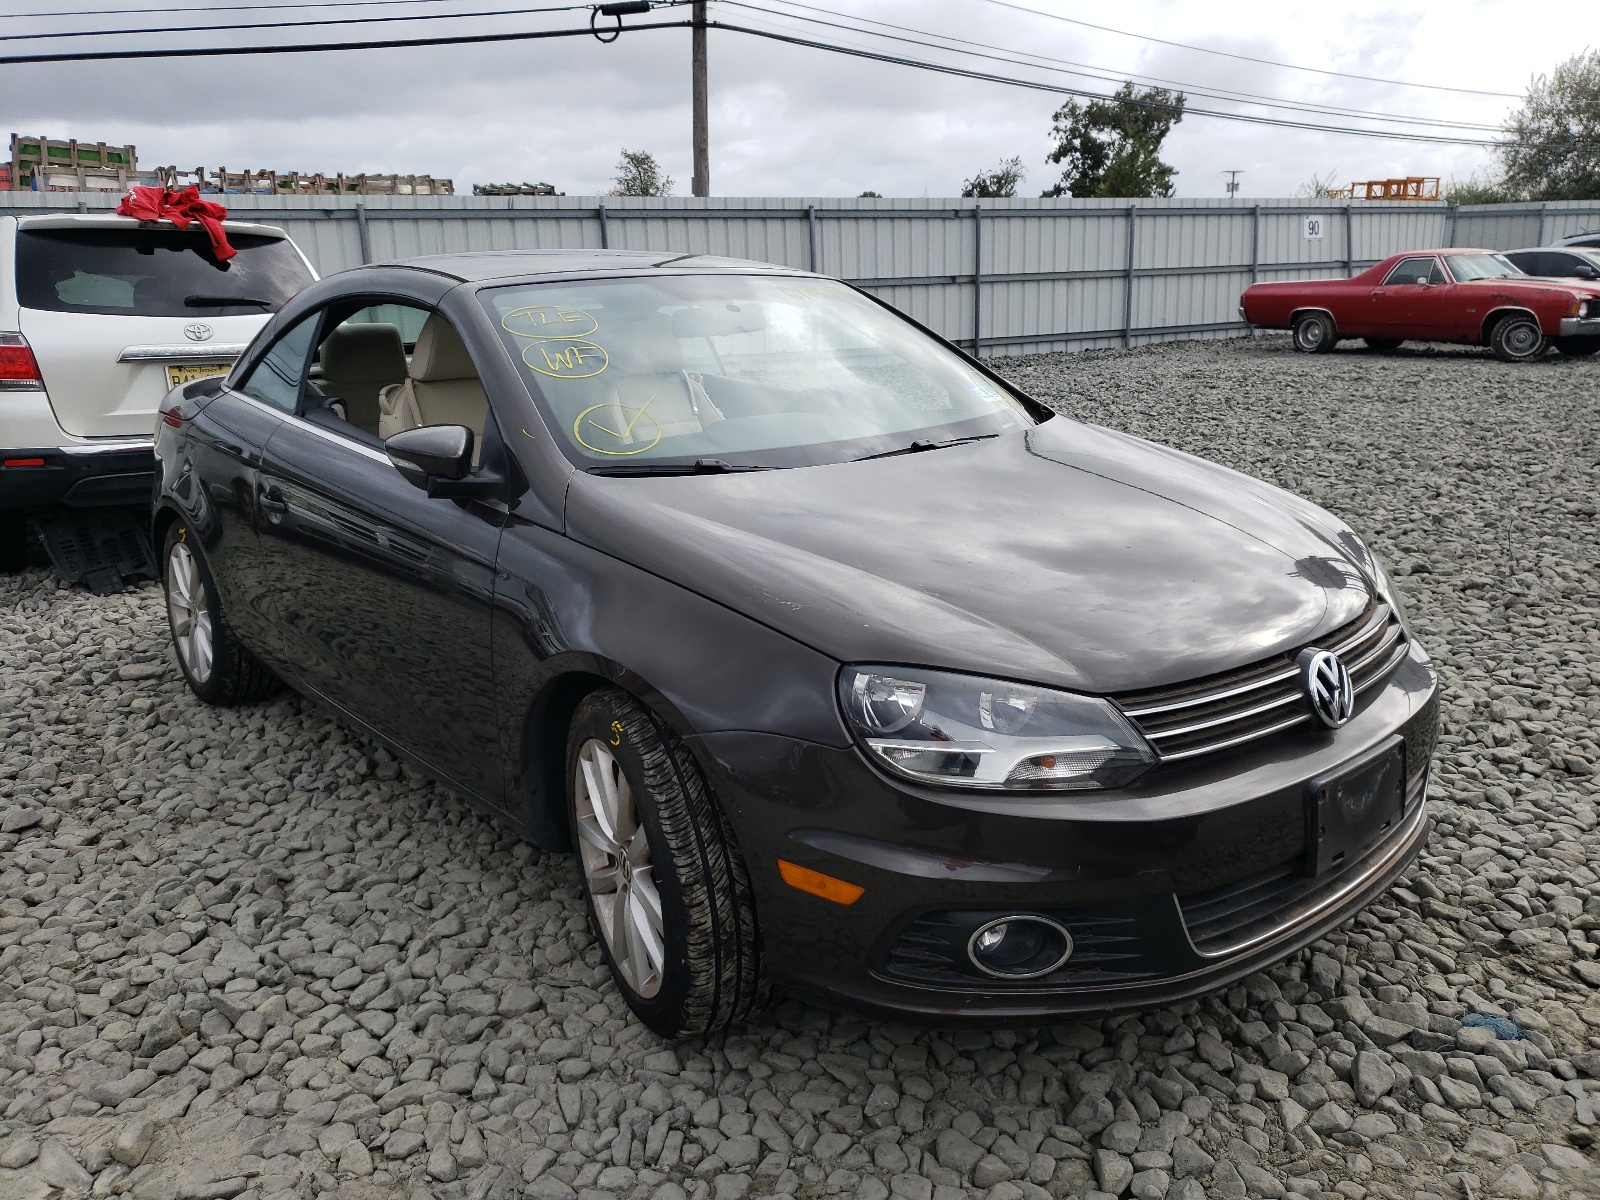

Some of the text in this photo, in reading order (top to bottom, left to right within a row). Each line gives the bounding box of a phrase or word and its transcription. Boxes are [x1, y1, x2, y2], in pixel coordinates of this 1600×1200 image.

[1308, 220, 1320, 235] 90
[512, 310, 588, 327] TLE
[540, 346, 602, 371] WF
[199, 366, 218, 374] Jersey
